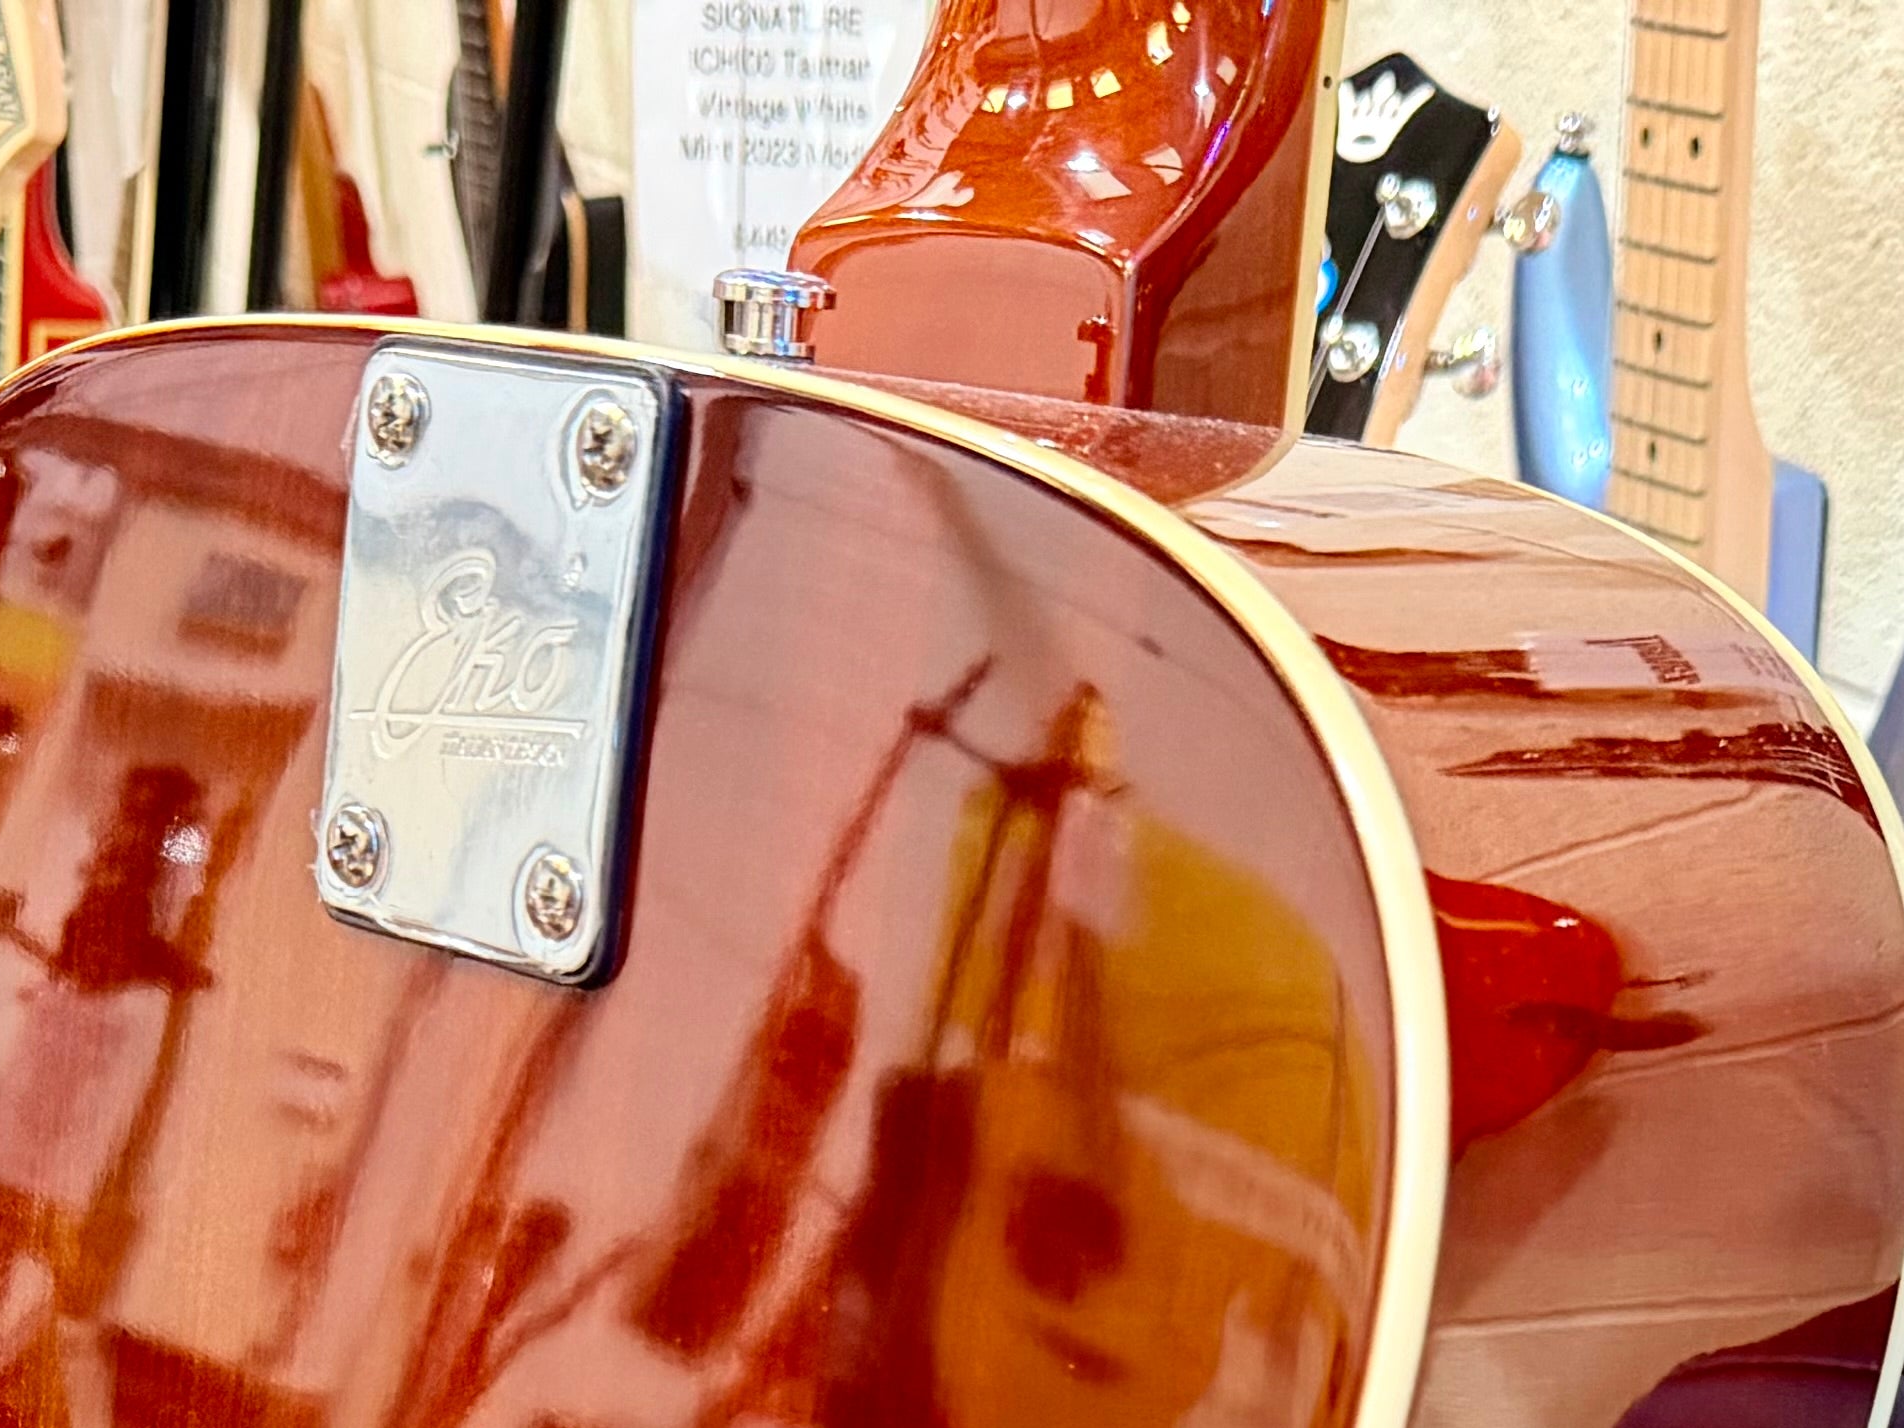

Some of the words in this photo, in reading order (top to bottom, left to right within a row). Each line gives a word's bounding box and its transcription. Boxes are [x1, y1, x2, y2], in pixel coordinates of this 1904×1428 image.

[702, 1, 863, 36] SIGNATURE
[741, 138, 799, 169] 2023
[368, 548, 580, 758] Eko
